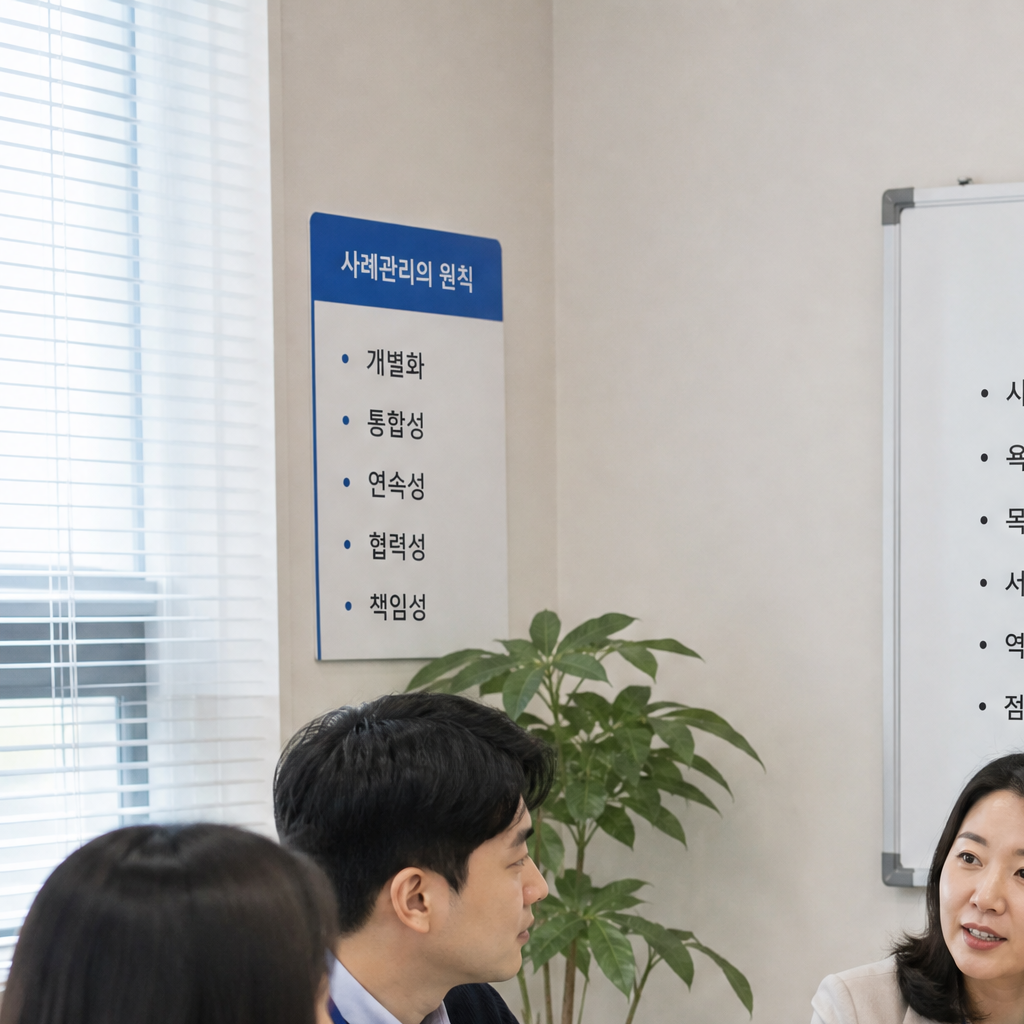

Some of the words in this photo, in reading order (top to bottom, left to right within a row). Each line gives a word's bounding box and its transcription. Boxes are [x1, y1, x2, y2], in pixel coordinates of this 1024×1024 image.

[340, 250, 433, 288] 사례관리의
[438, 262, 473, 294] 원칙
[366, 348, 425, 381] 개별화
[366, 408, 424, 441] 통합성
[368, 470, 425, 501] 연속성
[368, 531, 426, 562] 협력성
[369, 593, 426, 622] 책임성
